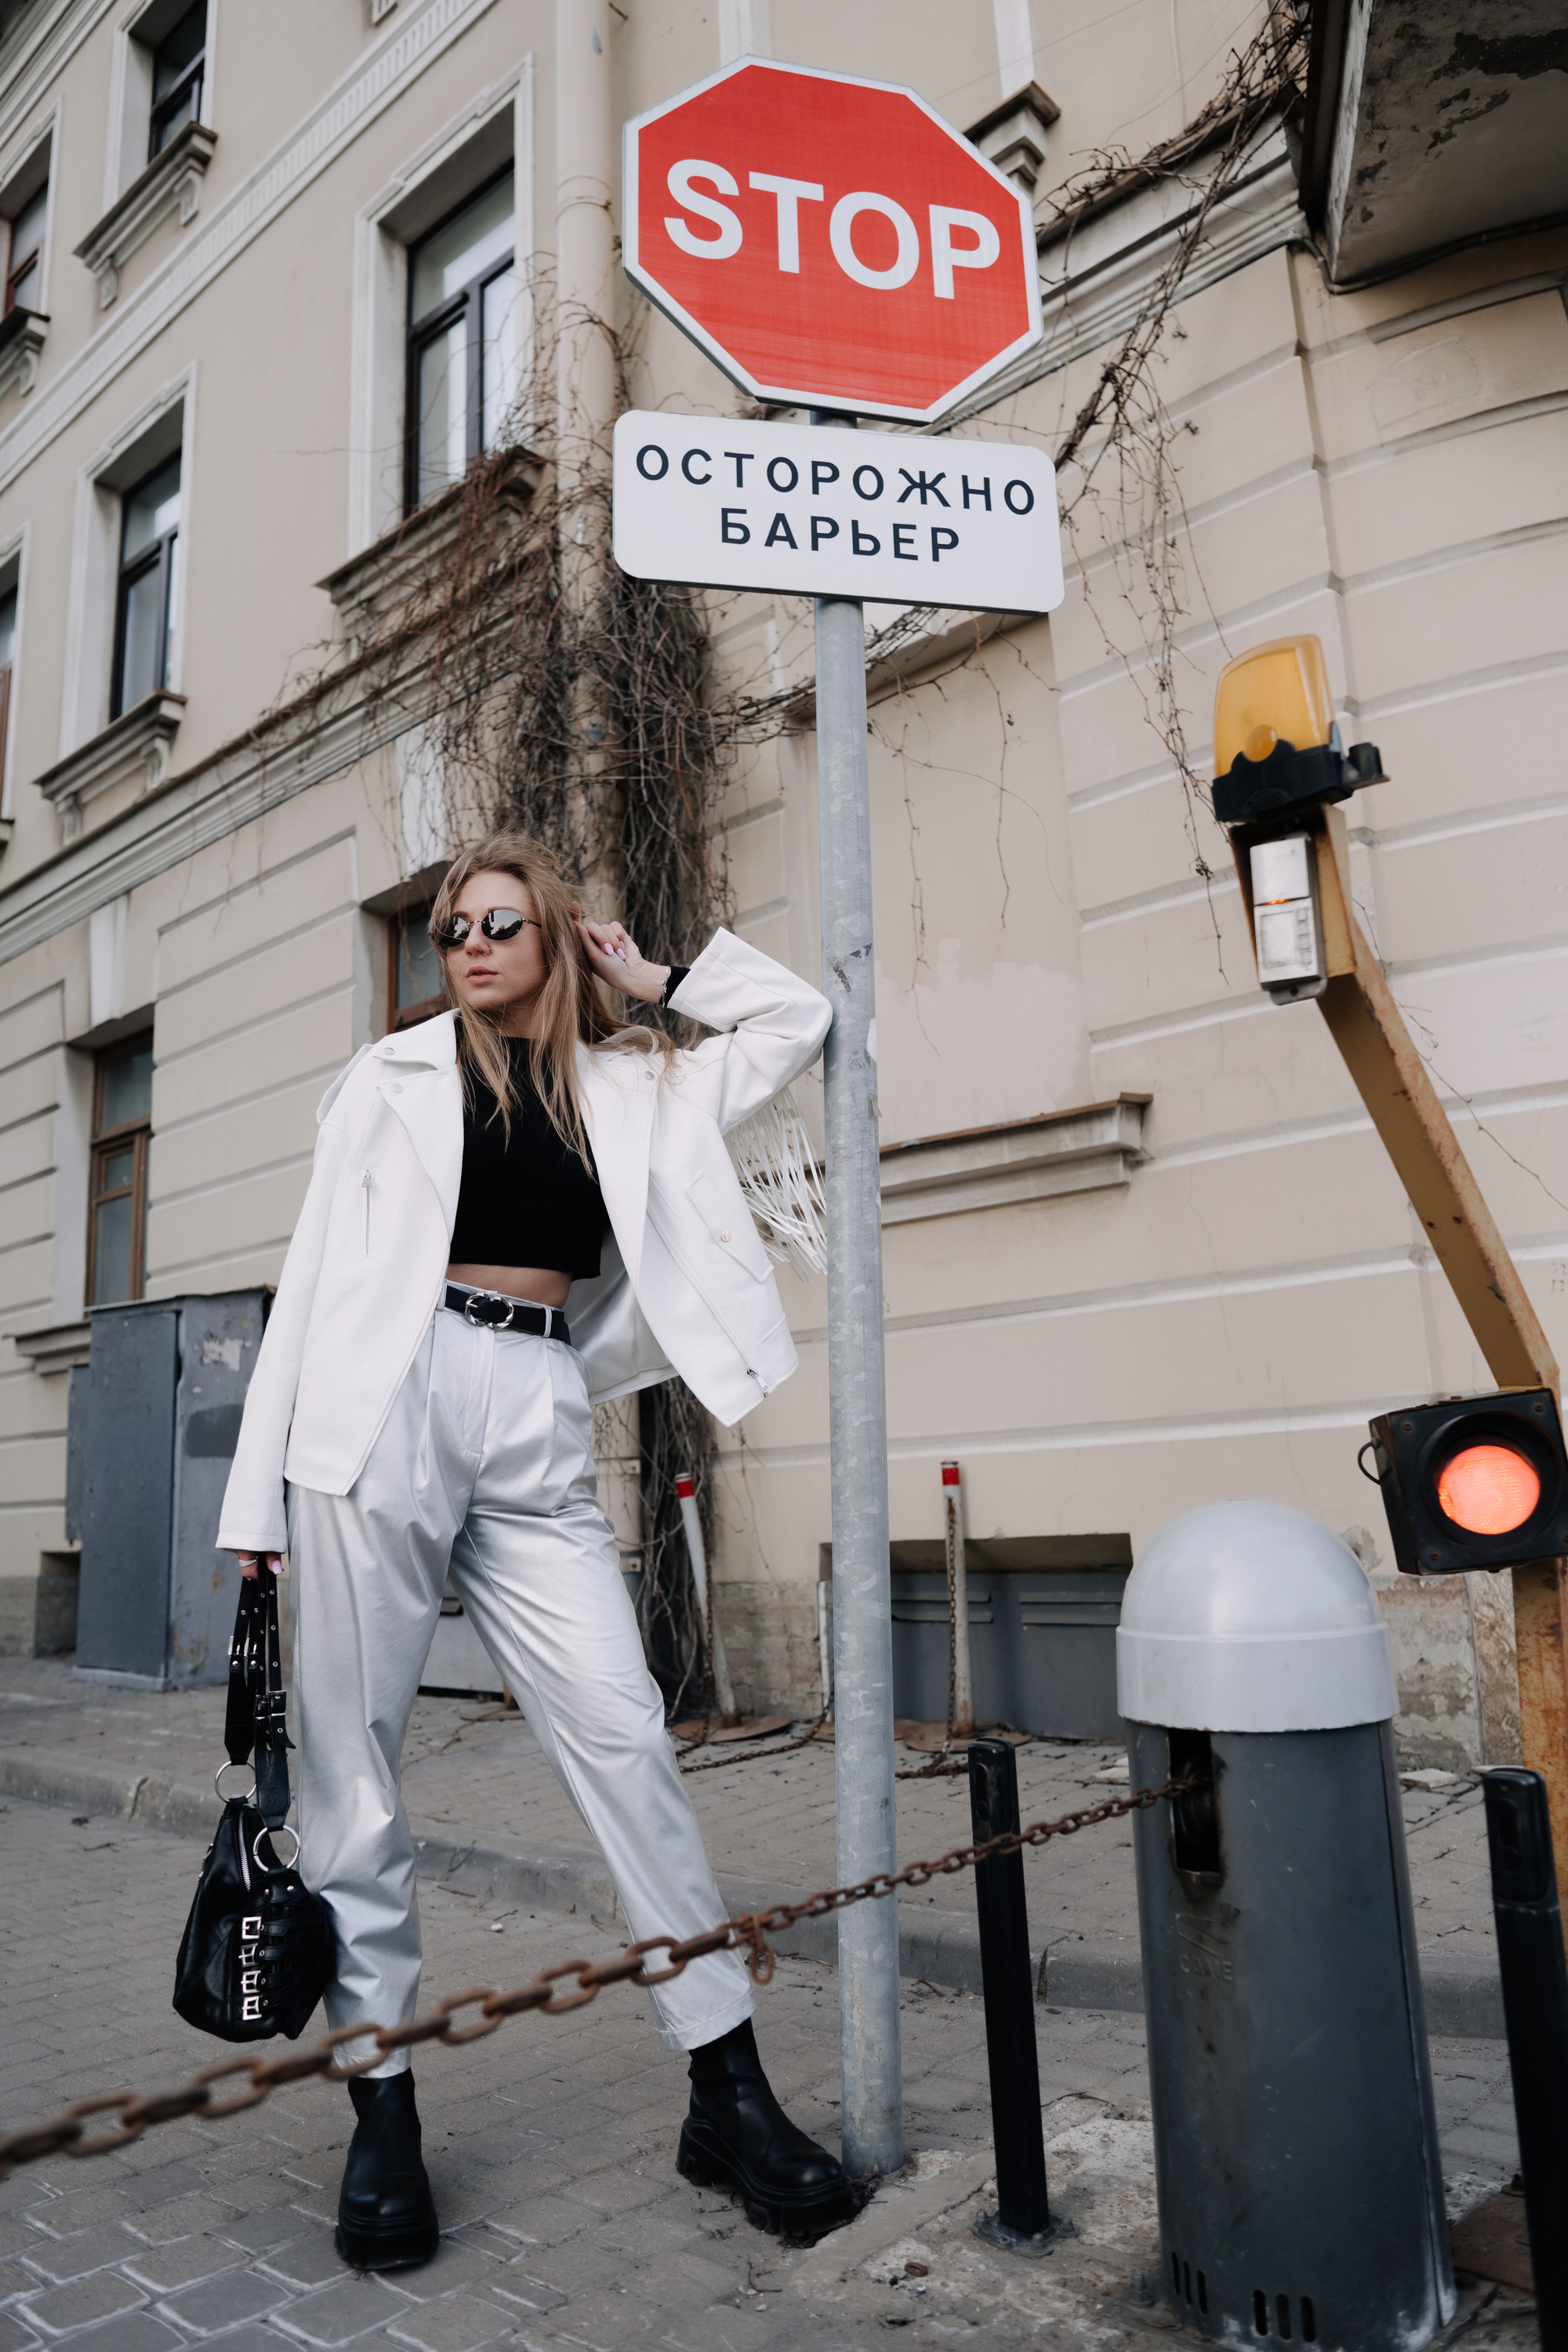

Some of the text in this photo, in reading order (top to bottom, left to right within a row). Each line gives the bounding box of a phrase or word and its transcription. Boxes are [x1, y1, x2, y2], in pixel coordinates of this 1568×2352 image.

[663, 158, 1000, 299] STOP
[636, 445, 1035, 515] ОСТОРОЖНО
[720, 507, 960, 562] БАРЬЕР
